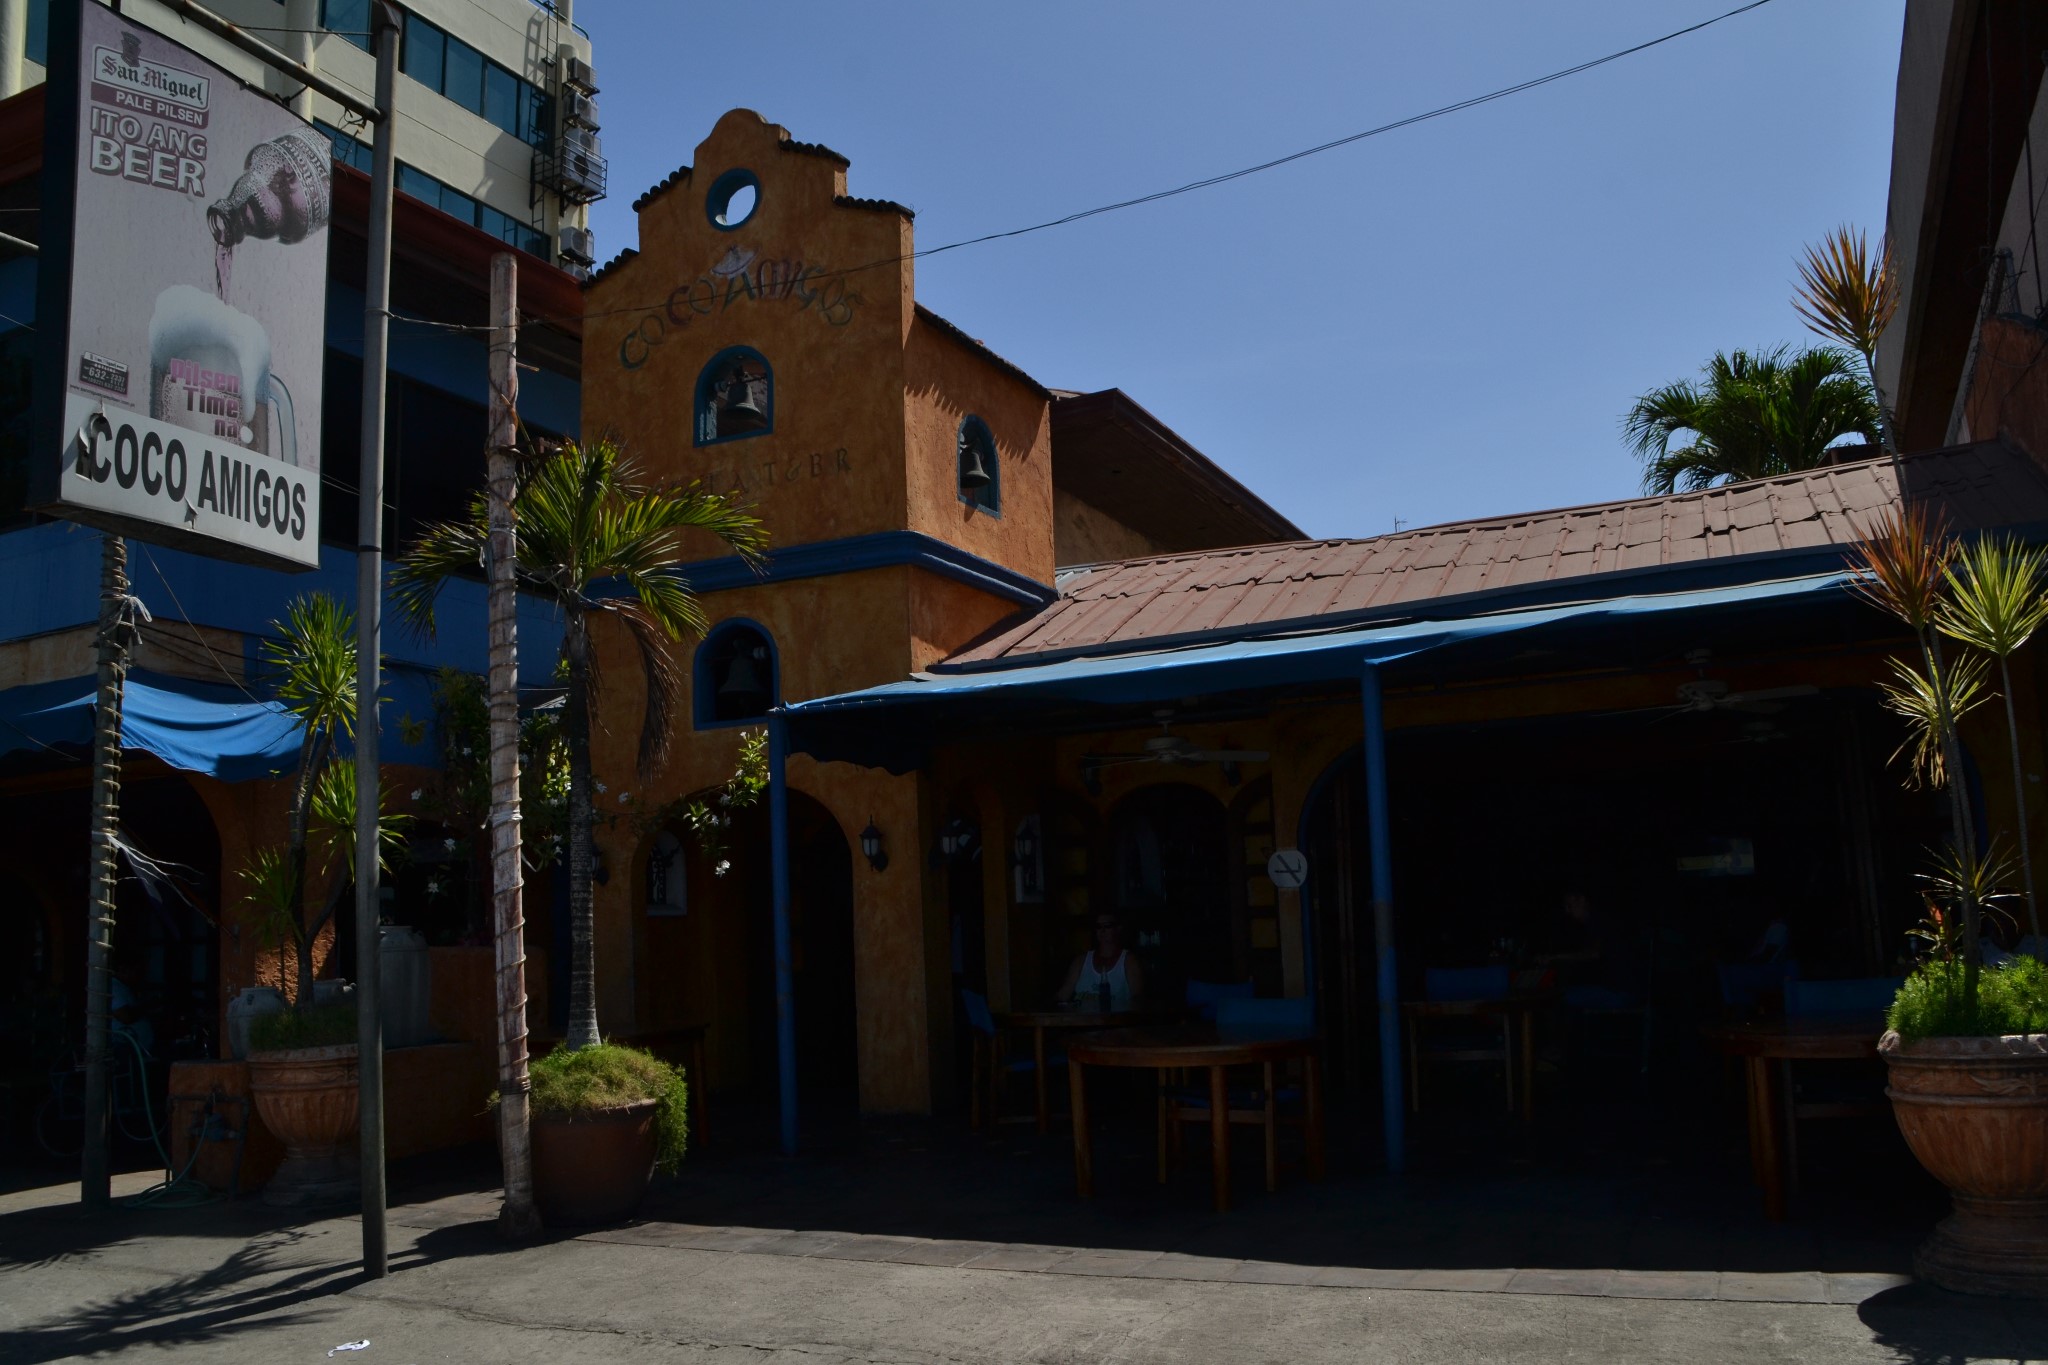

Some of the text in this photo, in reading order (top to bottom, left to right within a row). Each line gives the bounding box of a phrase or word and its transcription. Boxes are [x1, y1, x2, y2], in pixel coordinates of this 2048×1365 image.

[102, 55, 204, 101] San Miguel
[116, 91, 203, 126] PALE PILSEN
[91, 107, 207, 160] ITO ANG
[90, 135, 206, 197] BEER
[620, 276, 715, 370] COCO
[170, 357, 240, 394] Pilsen
[183, 386, 239, 419] Time
[214, 418, 239, 439] na
[90, 412, 307, 542] COCO AMIGOS
